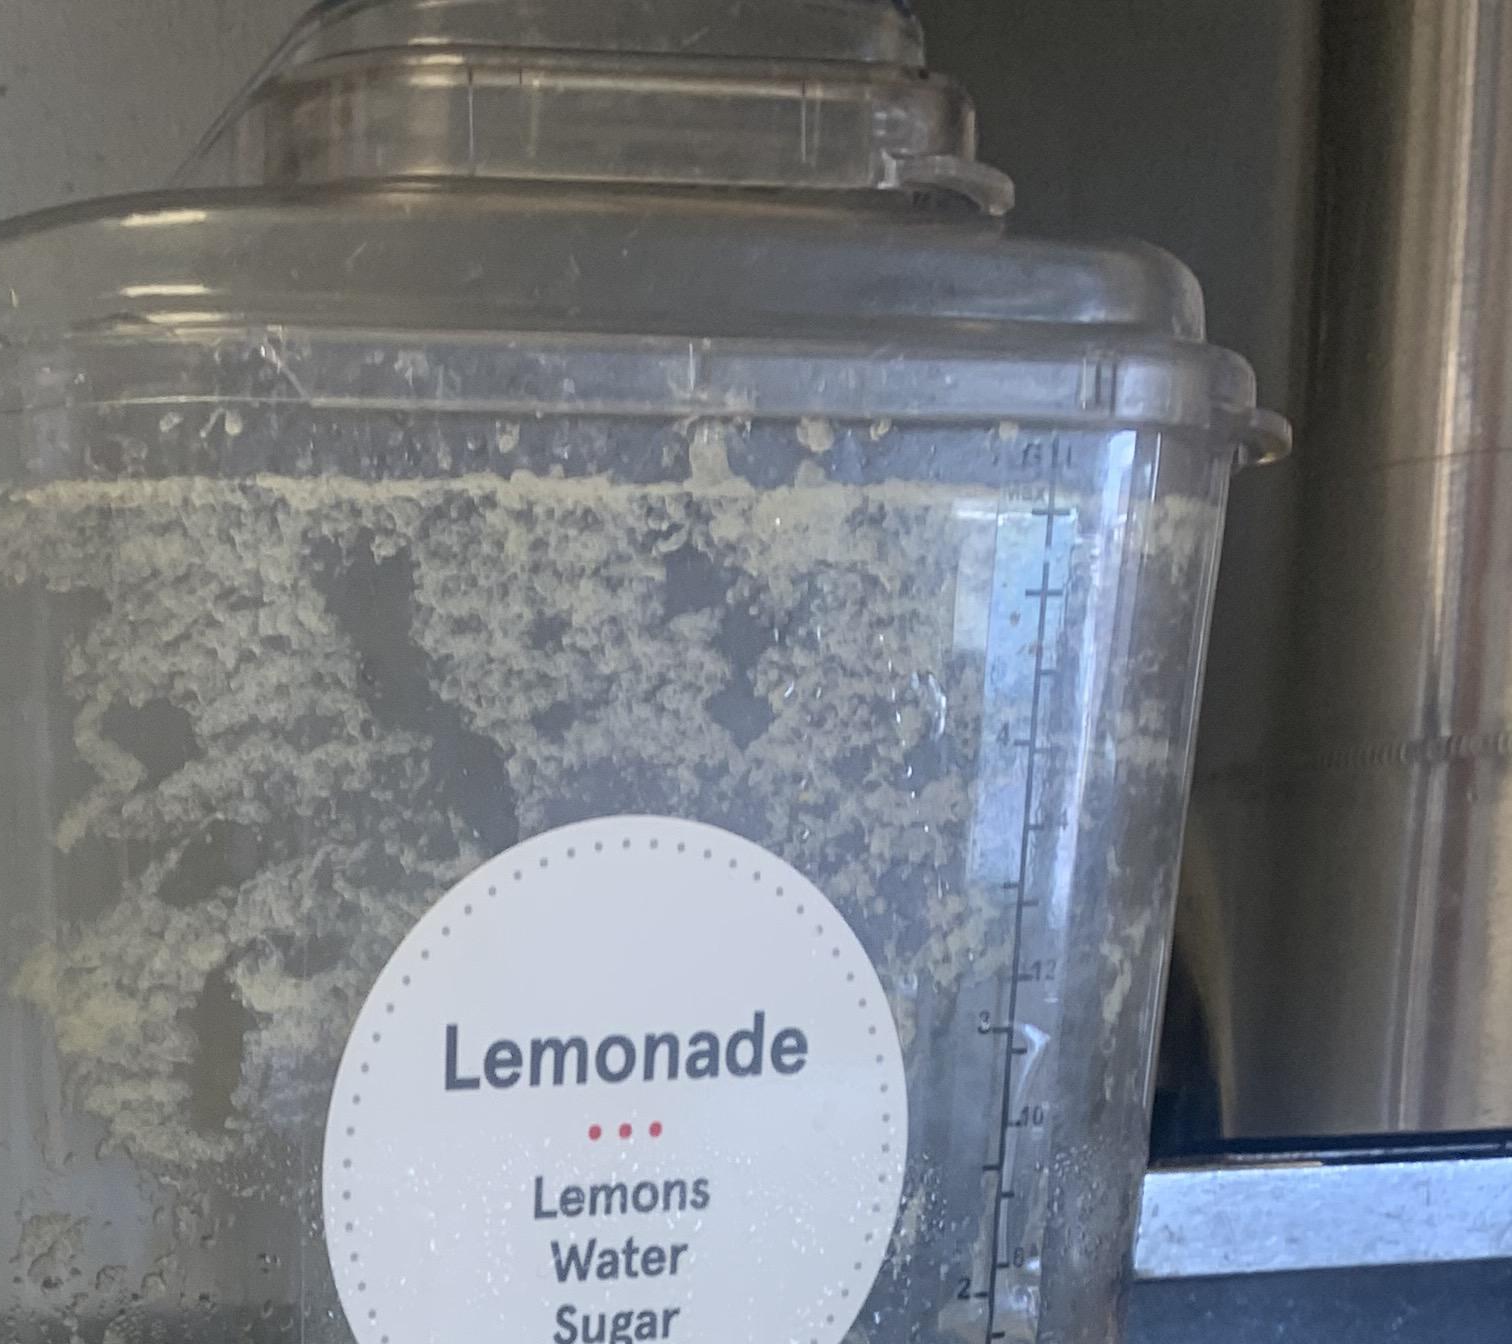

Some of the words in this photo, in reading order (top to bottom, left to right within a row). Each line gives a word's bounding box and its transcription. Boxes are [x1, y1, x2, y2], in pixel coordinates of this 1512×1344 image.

[444, 1011, 810, 1091] Lemonade
[533, 1173, 710, 1220] Lemons
[551, 1237, 688, 1283] Water
